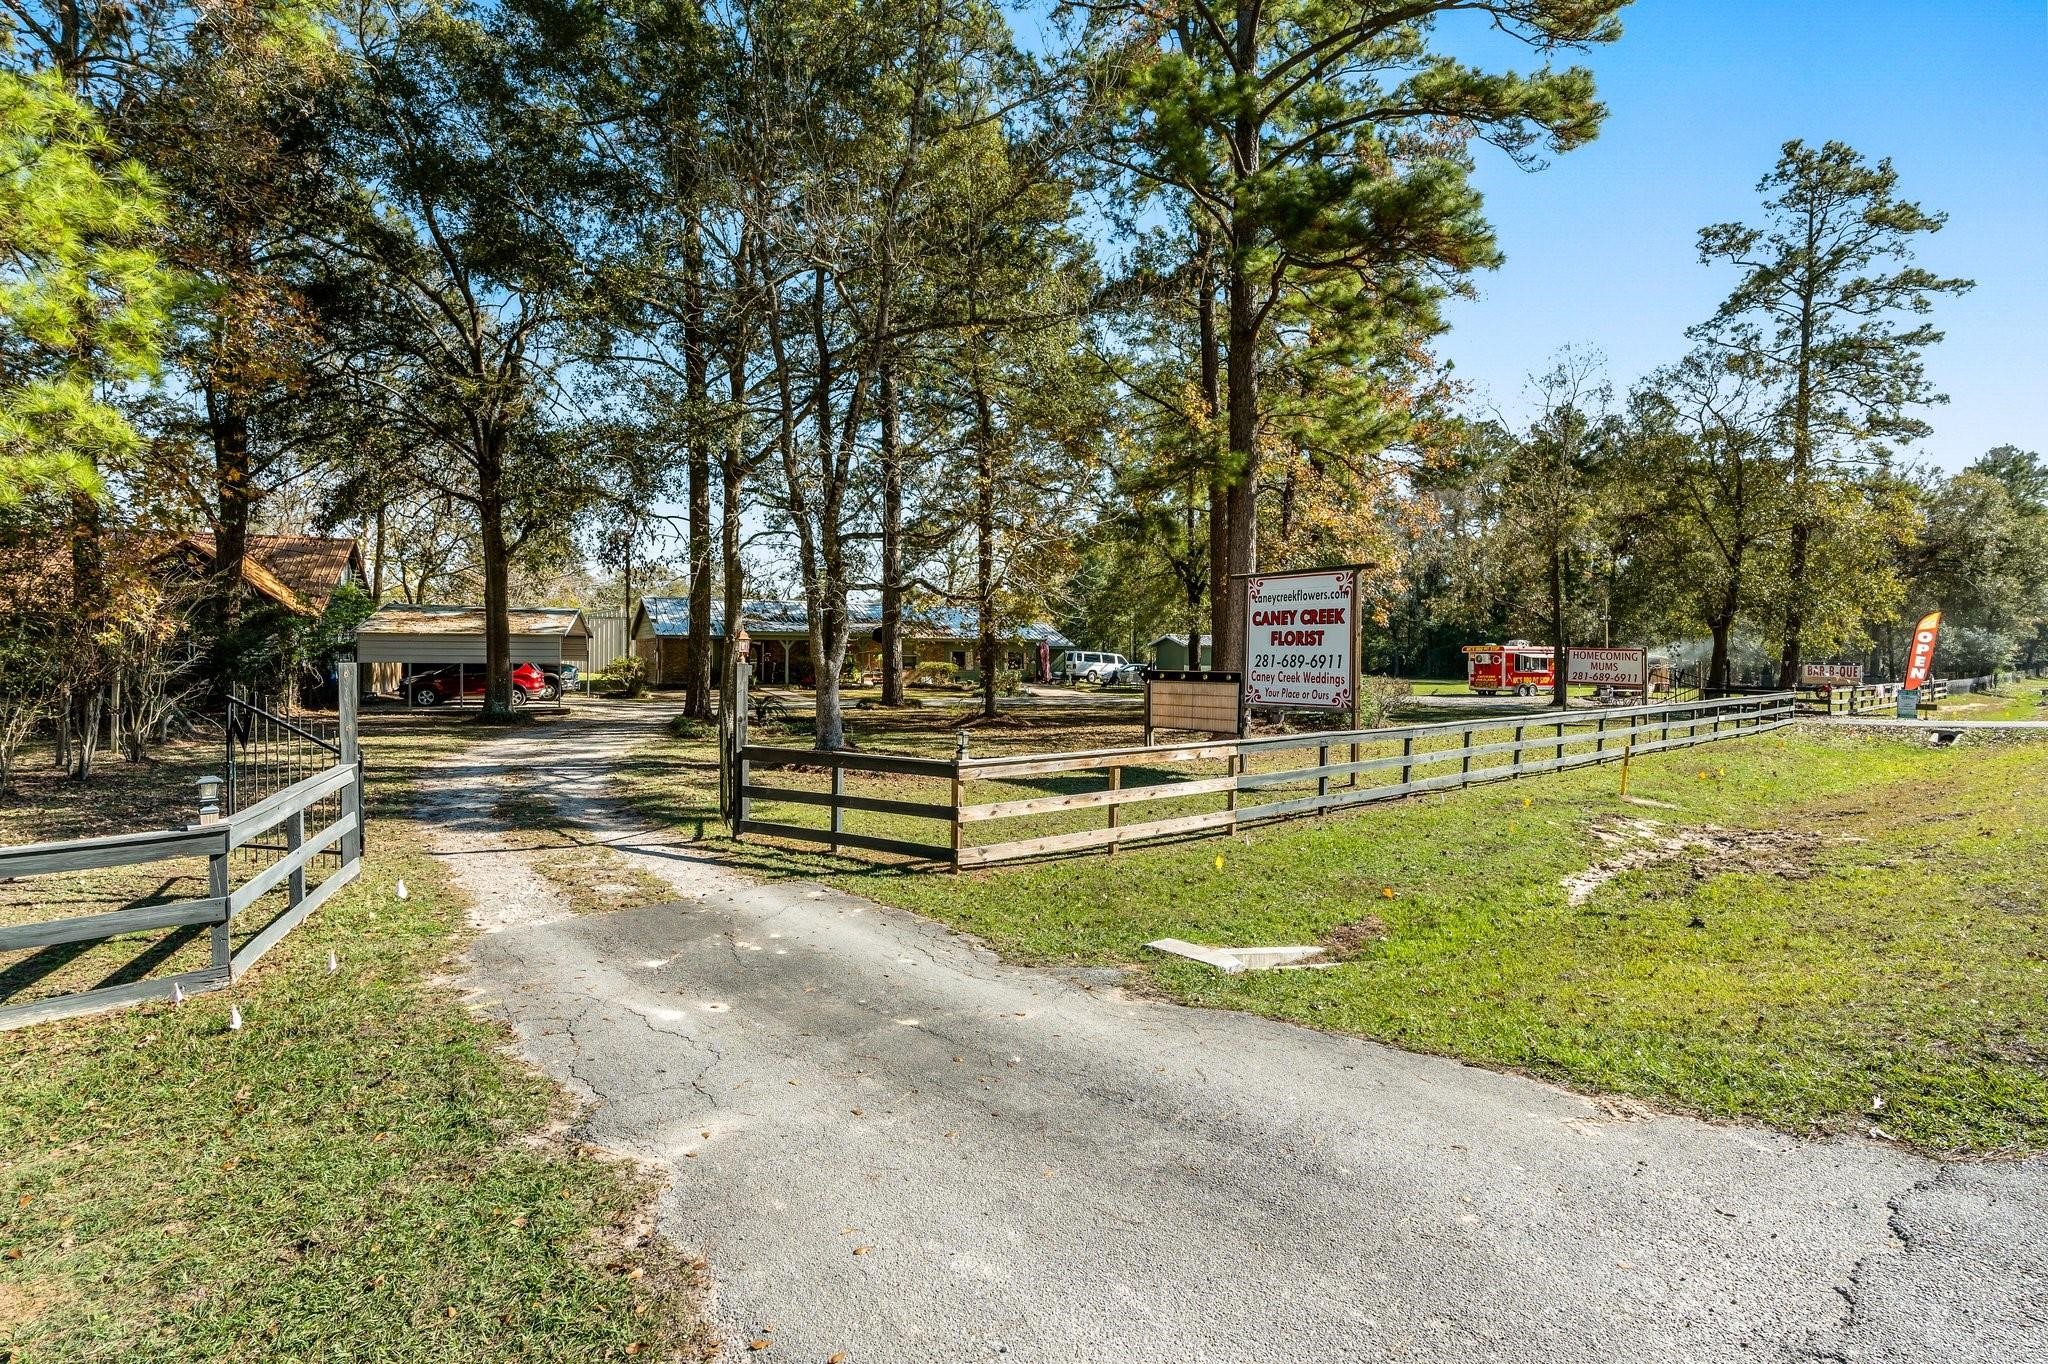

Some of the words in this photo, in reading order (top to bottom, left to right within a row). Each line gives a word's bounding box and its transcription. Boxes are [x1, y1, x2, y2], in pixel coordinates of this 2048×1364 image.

[1254, 589, 1349, 605] caneycreekflowers.com
[1252, 609, 1298, 626] CANEY
[1300, 608, 1346, 625] CREEK
[1270, 630, 1325, 646] FLORIST
[1254, 654, 1343, 669] 281-689-6911
[1573, 651, 1638, 661] HOMECOMING
[1909, 631, 1933, 679] OPEN
[1590, 662, 1619, 671] MUMS
[1807, 665, 1858, 677] BAR-B-QUE
[1251, 670, 1276, 684] Caney
[1278, 671, 1301, 683] Creek
[1303, 671, 1345, 688] Weddings
[1572, 671, 1638, 682] 281-689-6911
[1265, 687, 1280, 698] Your
[1281, 688, 1300, 699] Place
[1302, 691, 1310, 699] or
[1311, 689, 1330, 700] Ours
